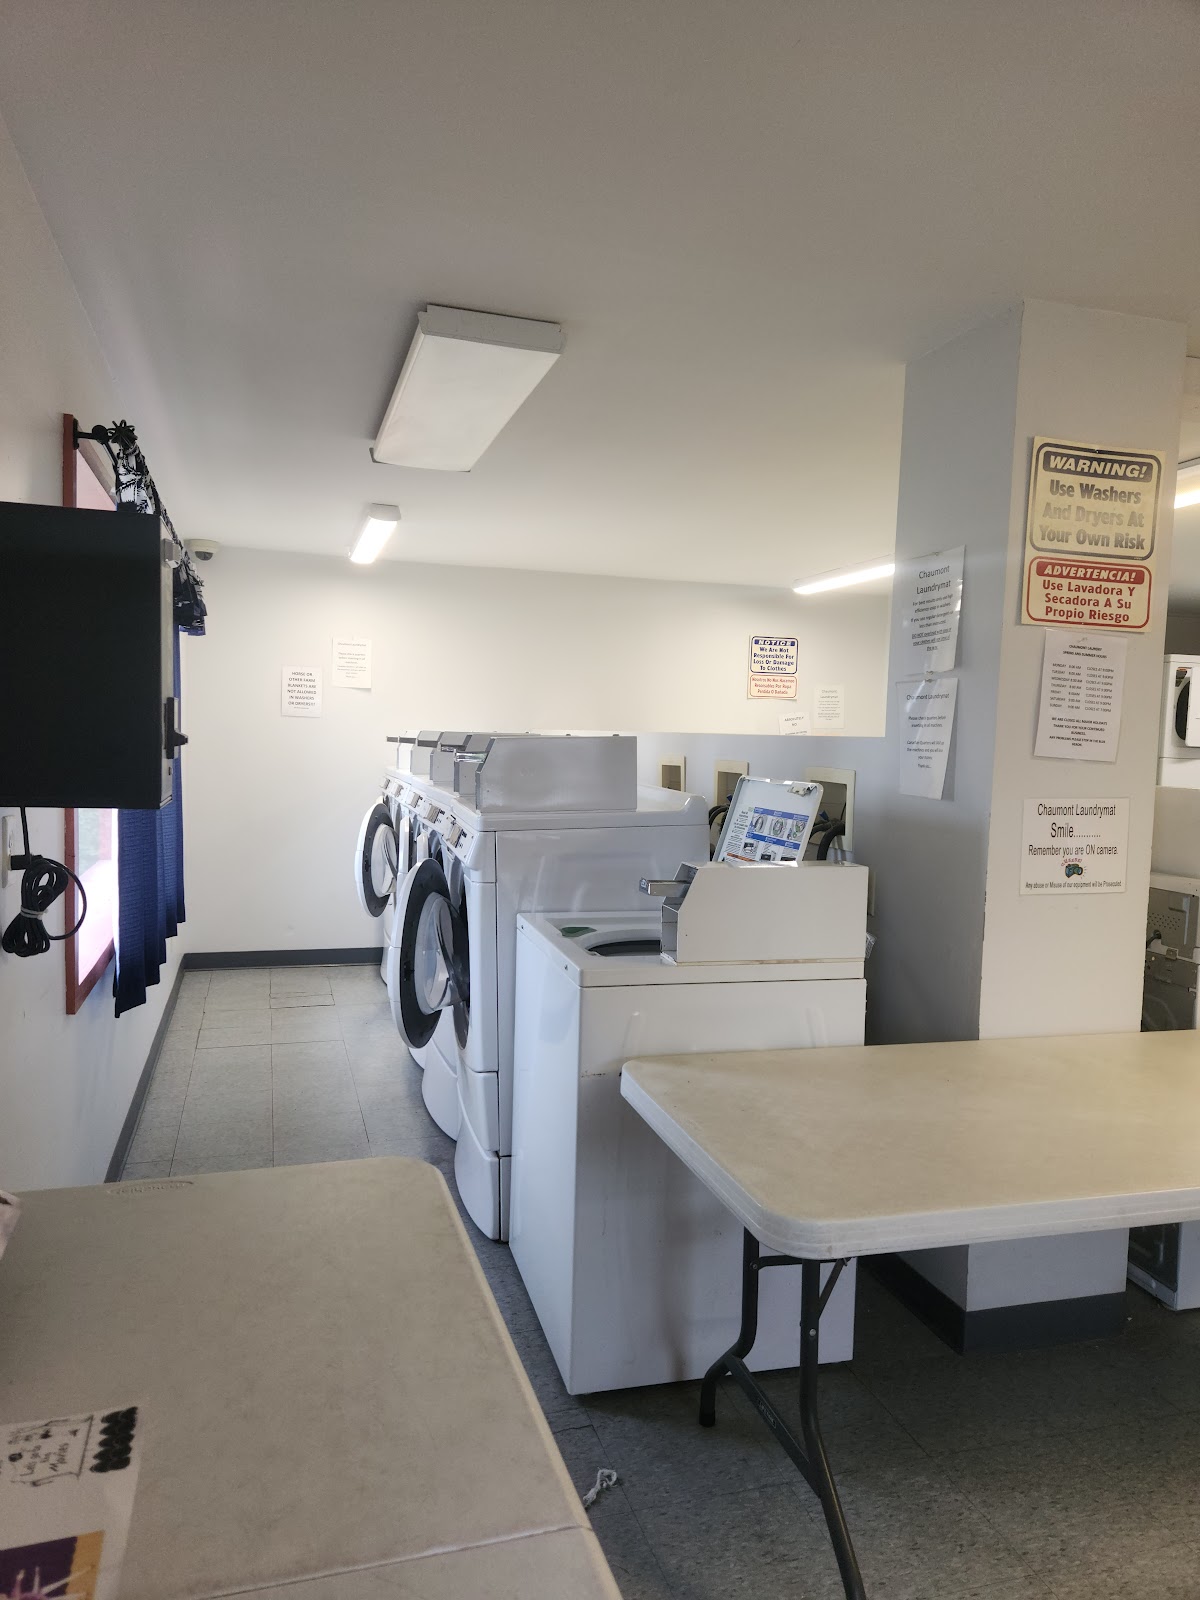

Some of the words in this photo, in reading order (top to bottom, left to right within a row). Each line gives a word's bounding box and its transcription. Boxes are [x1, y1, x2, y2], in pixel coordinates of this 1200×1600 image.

[1050, 455, 1148, 478] WARNING!
[1050, 480, 1075, 498] Use
[1080, 483, 1142, 504] Washers
[1042, 502, 1072, 520] And
[1076, 506, 1124, 527] Dryers
[1128, 511, 1144, 528] At
[1040, 525, 1072, 543] Your
[1076, 530, 1110, 547] Own
[1114, 533, 1146, 550] Risk
[918, 565, 950, 579] Chaumont
[1044, 565, 1136, 582] ADVERTENCIA!
[916, 580, 951, 594] Laundrymat
[1042, 580, 1063, 591] Use
[1068, 582, 1123, 596] Lavadora
[1128, 586, 1136, 597] Y
[1044, 593, 1100, 607] Secadora
[1104, 598, 1112, 608] A
[1117, 599, 1132, 609] Su
[1045, 606, 1084, 620] Propio
[1089, 610, 1130, 623] Riesgo
[1037, 804, 1074, 816] Chaumont
[1076, 804, 1116, 818] Laundrymat
[1028, 845, 1061, 855] Remember
[1063, 847, 1073, 858] you
[1086, 844, 1095, 855] ON
[1096, 846, 1118, 855] camera.
